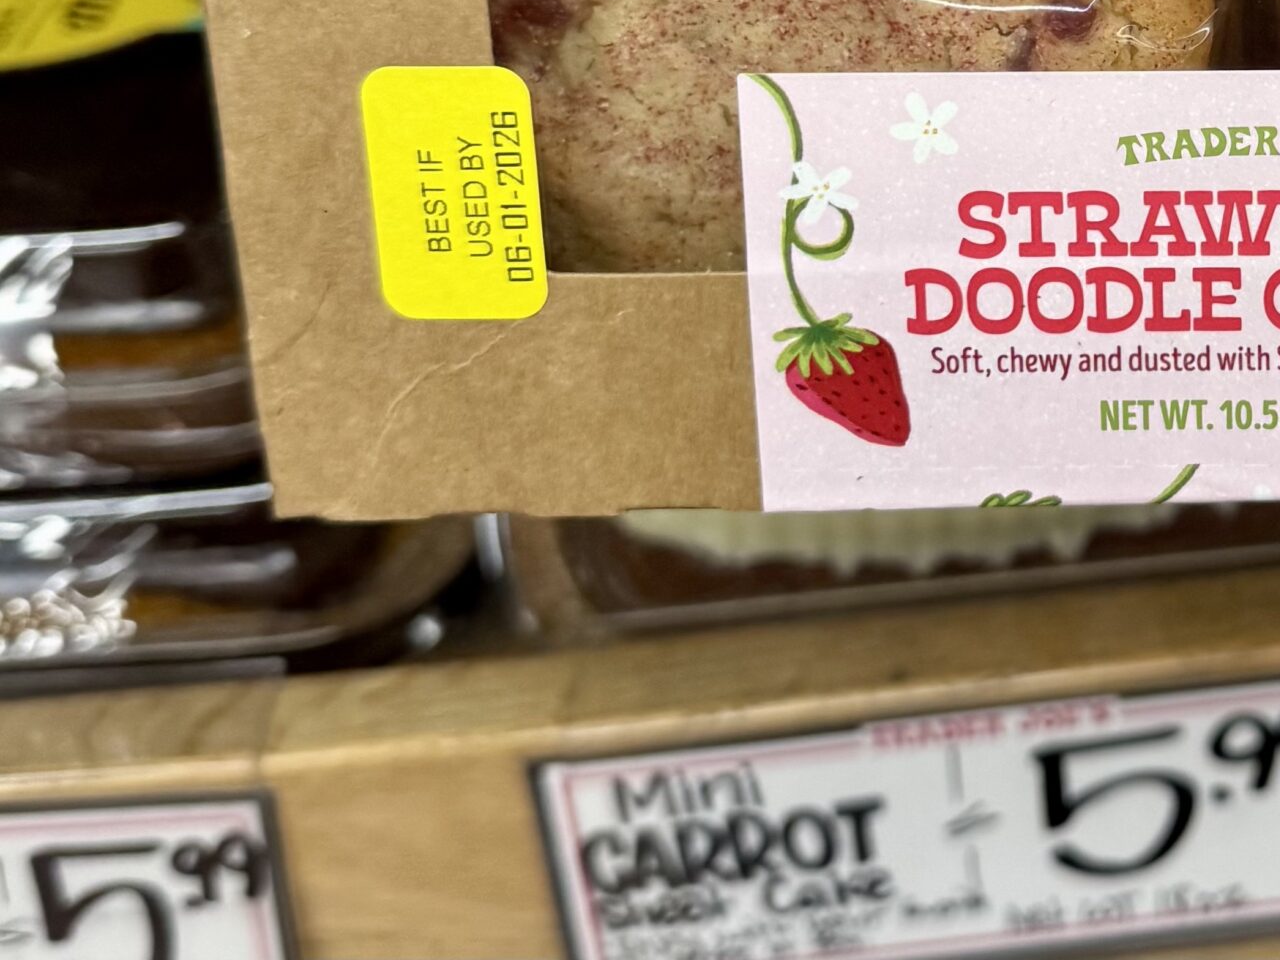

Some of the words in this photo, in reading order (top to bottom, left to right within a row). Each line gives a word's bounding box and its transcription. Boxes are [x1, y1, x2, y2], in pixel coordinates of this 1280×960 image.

[416, 149, 444, 172] IF
[457, 136, 485, 171] BY
[1116, 126, 1280, 167] TRADER
[420, 182, 453, 252] BEST
[462, 180, 495, 258] USED
[490, 110, 535, 283] 06-01-2026
[904, 266, 1243, 335] DOODLE
[930, 346, 992, 378] Soft,
[996, 347, 1072, 381] chewy
[1078, 346, 1123, 373] and
[1128, 345, 1211, 372] dusted
[1217, 345, 1271, 372] with
[1099, 400, 1155, 431] NET
[1160, 399, 1214, 431] WT.
[611, 759, 765, 823] Mini
[582, 792, 888, 894] CARROT
